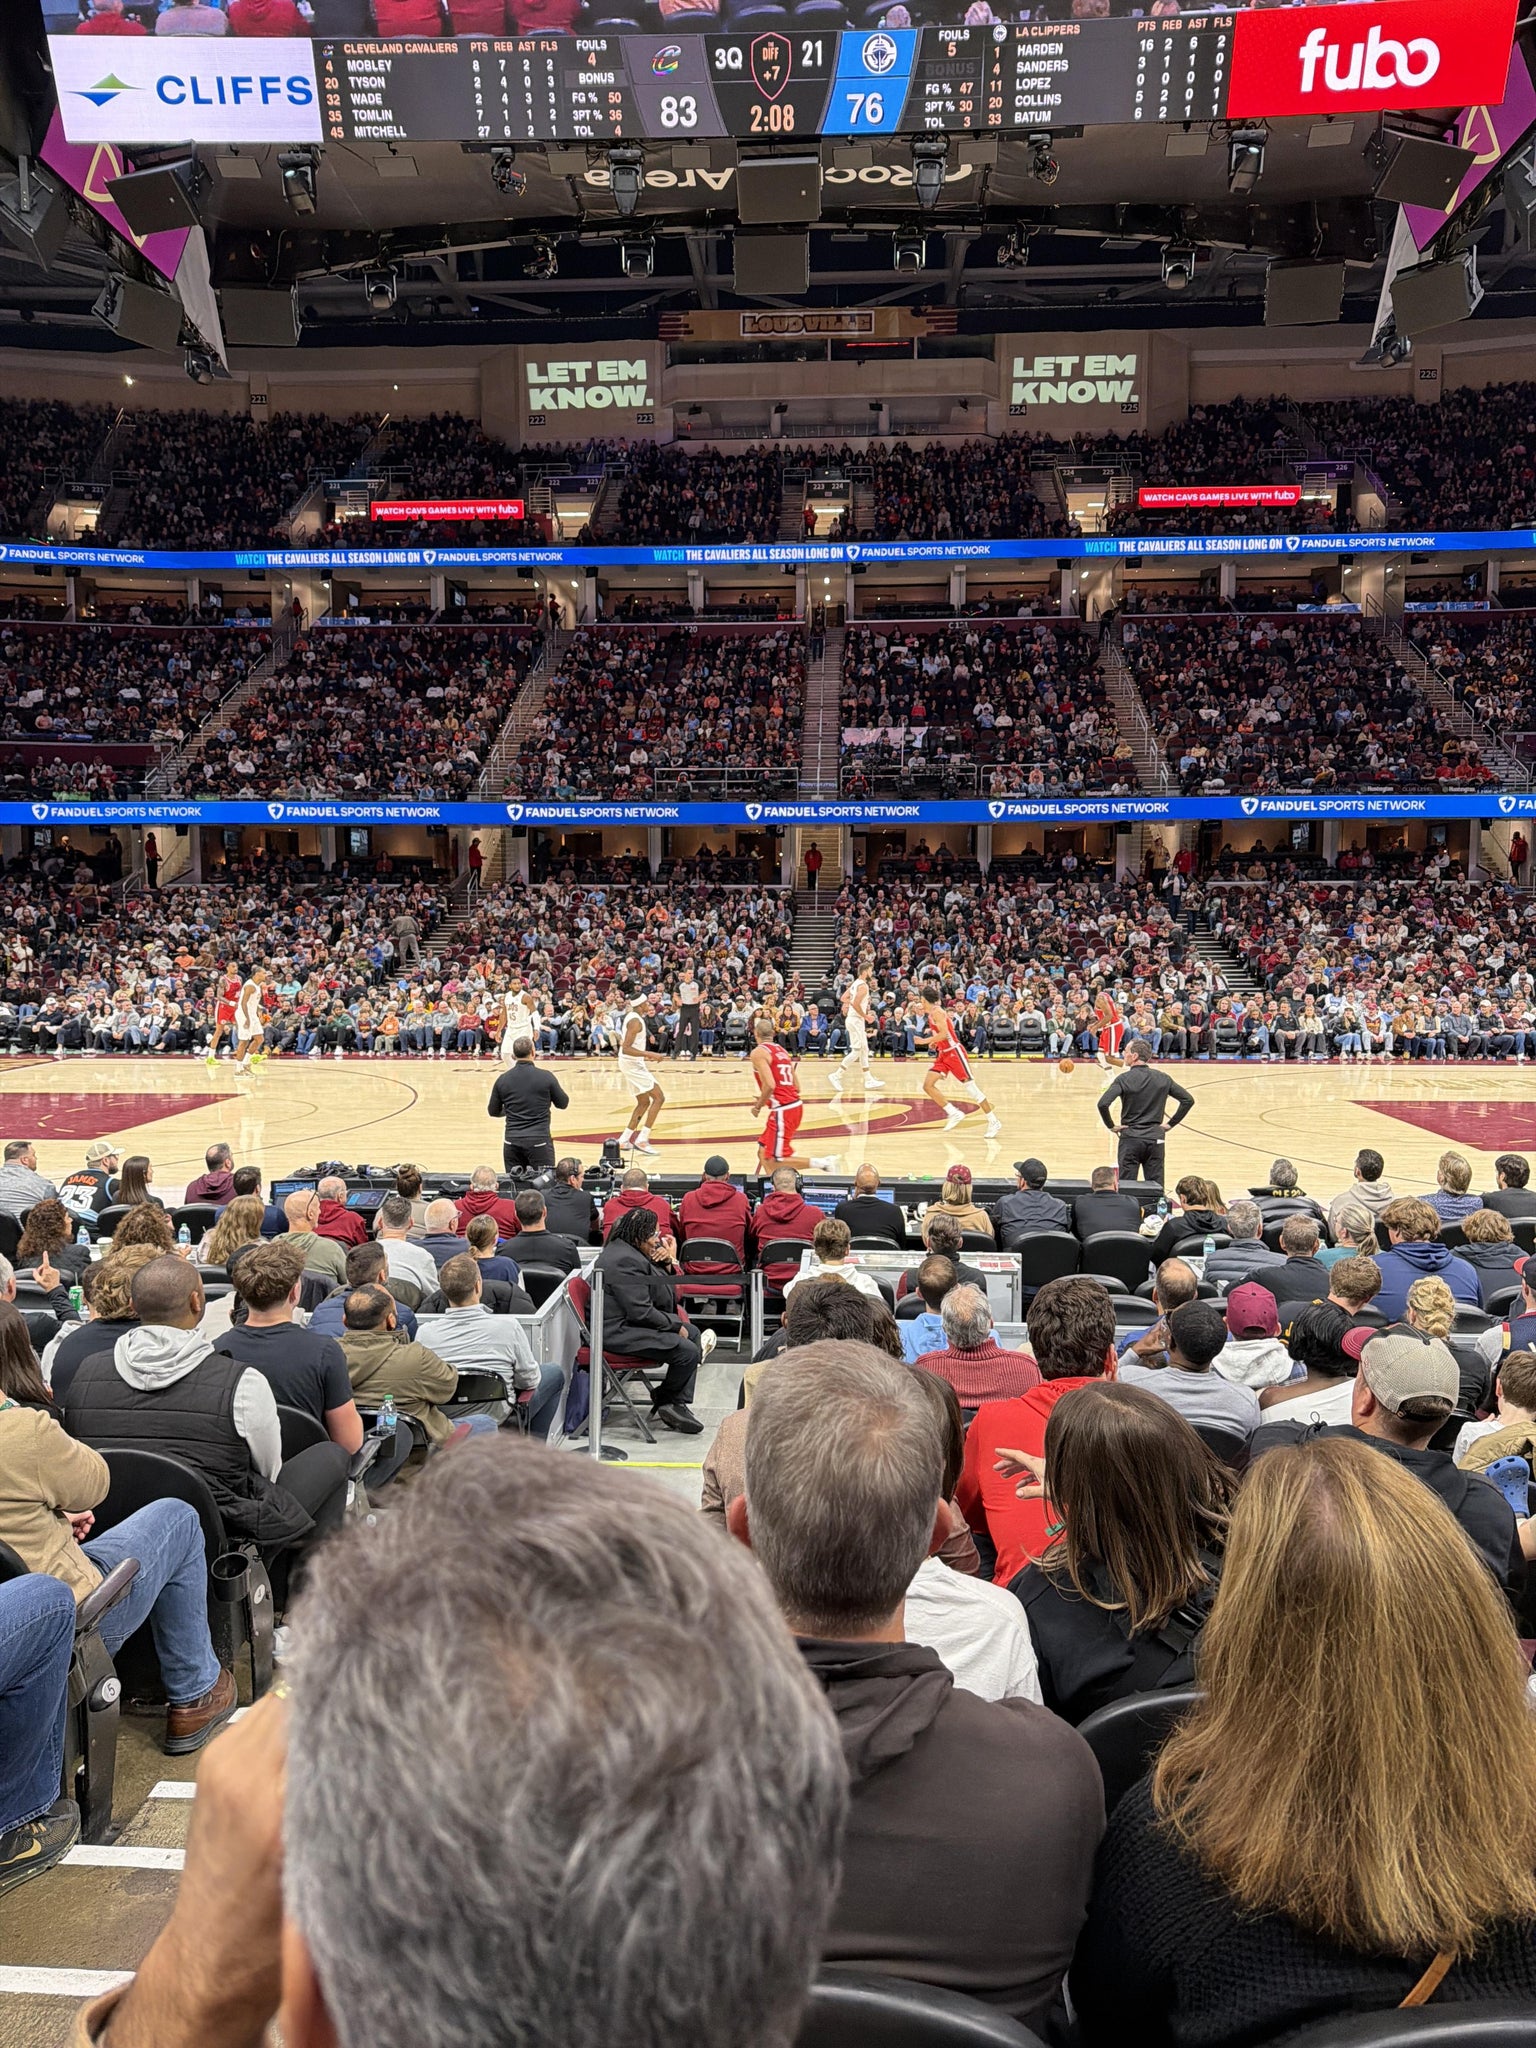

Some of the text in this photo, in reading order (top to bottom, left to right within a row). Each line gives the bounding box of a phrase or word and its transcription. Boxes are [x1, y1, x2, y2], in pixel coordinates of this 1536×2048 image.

[1015, 16, 1233, 37] LA CLIPPERS PTS REB AST FLS
[938, 29, 970, 42] FOULS
[343, 41, 558, 54] CLEVELAND CAVALIERS PTS REB AST FLS
[576, 40, 607, 50] FOULS
[947, 42, 956, 57] 5
[994, 38, 1154, 59] 1 HARDEN 16
[587, 52, 596, 66] 4
[715, 47, 743, 70] 3Q
[762, 47, 779, 61] DIFF
[802, 40, 823, 68] 21
[1298, 25, 1441, 93] fubo
[325, 60, 392, 73] 4 MOBLEY
[992, 59, 1069, 76] 4 SANDERS
[578, 72, 614, 84] BONUS
[763, 66, 781, 81] +7
[324, 76, 386, 89] 20 TYSON
[925, 82, 974, 95] FG % 47
[990, 78, 1052, 92] 11 LOPEZ
[156, 75, 313, 105] CLIFFS
[326, 93, 383, 106] 32 WADE
[572, 92, 622, 104] FG % 50
[989, 94, 1062, 109] 20 COLLINS
[660, 96, 698, 128] 83
[846, 92, 884, 126] 76
[925, 100, 973, 112] 3PT % 30
[328, 109, 393, 122] 35 TOMLIN
[572, 109, 622, 122] 3PT % 36
[750, 104, 795, 133] 2:08
[925, 116, 971, 128] TOL 3
[988, 111, 1052, 126] 33 BATUM
[330, 126, 491, 139] 45 MITCHELL 27
[574, 125, 622, 137] TOL 4
[584, 168, 735, 190] Area
[743, 313, 873, 335] LOUDVILLE
[526, 359, 647, 384] LET EM
[1012, 354, 1138, 378] LET EM
[1420, 368, 1437, 379] 226
[528, 384, 655, 411] KNOW.
[1011, 380, 1140, 404] KNOW.
[251, 394, 267, 404] 221
[1010, 405, 1026, 416] 224
[1122, 403, 1139, 414] 225
[529, 416, 546, 425] 222
[637, 414, 654, 424] 223
[1144, 494, 1174, 502] WATCH
[1231, 492, 1248, 500] LIVE
[1250, 492, 1272, 500] WITH
[1274, 490, 1295, 500] fubo
[428, 506, 457, 514] GAMES
[458, 506, 474, 514] LIVE
[498, 504, 518, 513] fubo
[1085, 538, 1435, 552] WATCH THE CAVALIERS ALL SEASON LONG ON FANDUEL SPORTS NETWORK
[9, 549, 145, 564] FANDUEL SPORTS NETWORK
[235, 552, 563, 565] WATCH THE CAVALIERS ALL SEASON LONG ON FANDUEL SPORTS NETWORK
[654, 546, 990, 561] WATCH THE CAVALIERS ALL SEASON LONG ON FANDUEL SPORTS NETWORK
[51, 806, 202, 817] FANDUEL SPORTS NETWORK
[286, 806, 440, 816] FANDUEL SPORTS NETWORK
[764, 806, 920, 816] FANDUEL SPORTS NETWORK
[1008, 802, 1169, 815] FANDUEL SPORTS NETWORK
[1261, 800, 1426, 812] FANDUEL SPORTS NETWORK
[526, 808, 678, 818] FANDUEL SPORTS NETWORK
[67, 1174, 99, 1186] JAMES
[59, 1184, 98, 1213] 23
[106, 1683, 116, 1697] 5
